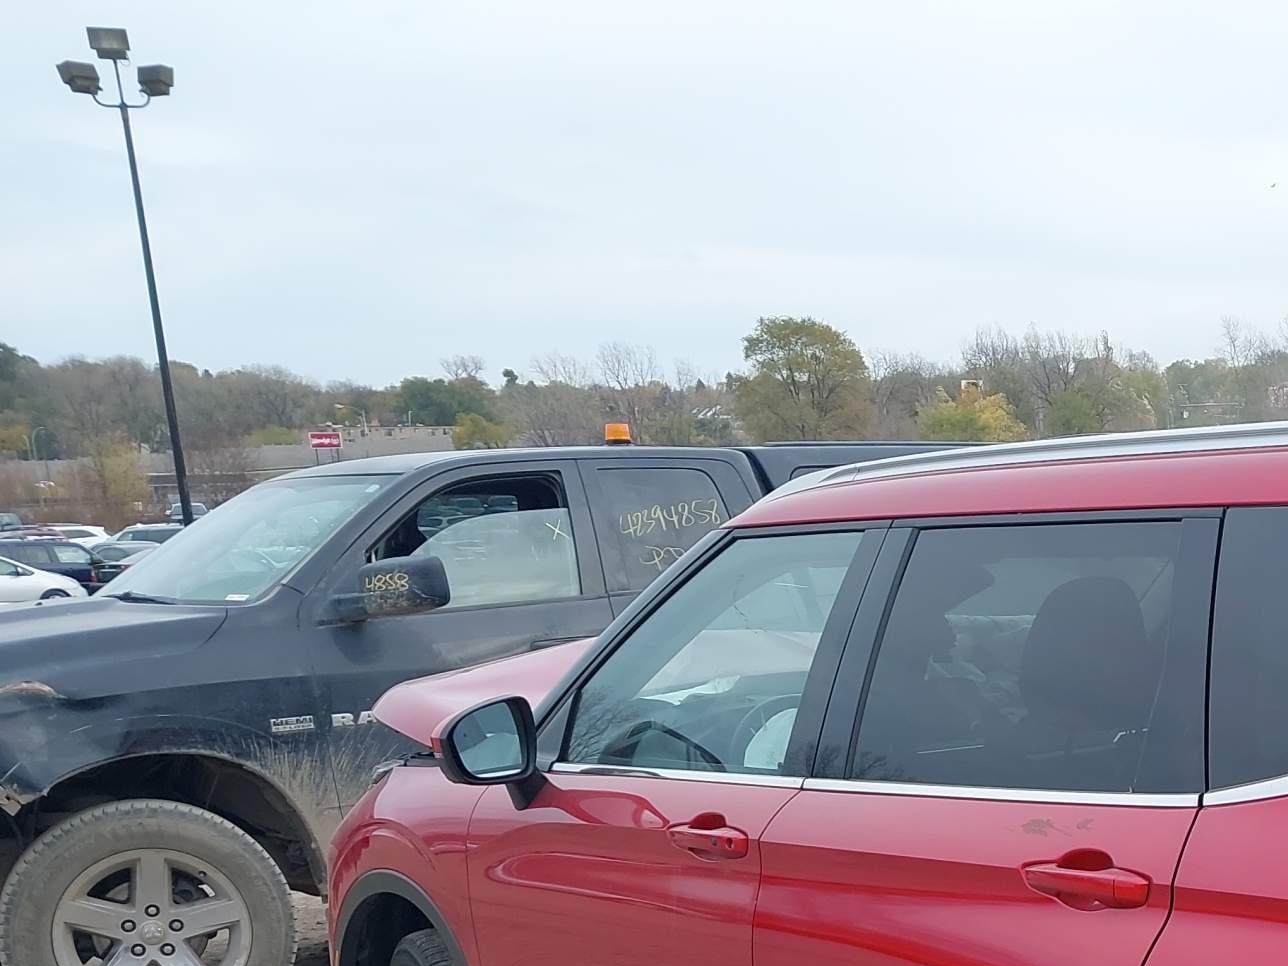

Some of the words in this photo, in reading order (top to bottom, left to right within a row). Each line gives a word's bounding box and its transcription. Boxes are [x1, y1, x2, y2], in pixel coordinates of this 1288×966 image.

[365, 572, 410, 592] 4858
[272, 715, 314, 727] HEMI
[330, 710, 377, 728] RA
